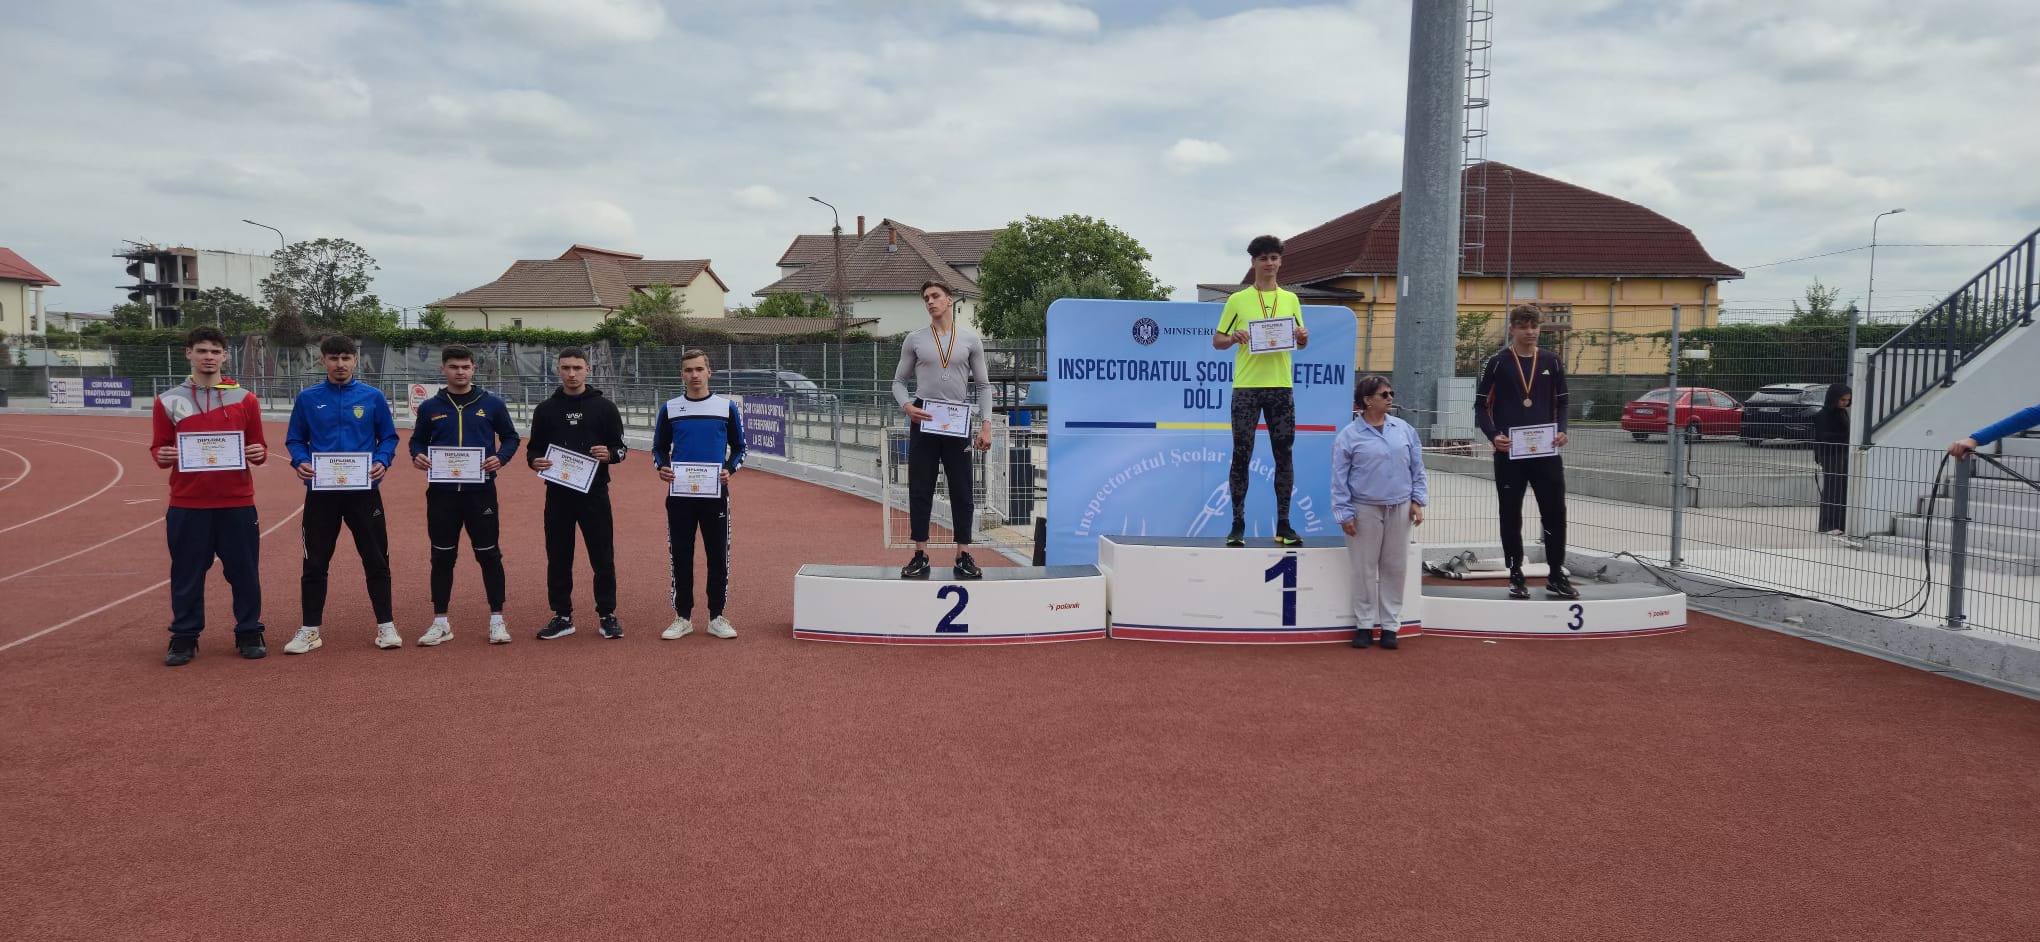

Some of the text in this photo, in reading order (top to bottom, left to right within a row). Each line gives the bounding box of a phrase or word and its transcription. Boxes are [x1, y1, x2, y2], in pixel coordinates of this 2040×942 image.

[1163, 328, 1217, 336] MINISTERU
[1058, 358, 1345, 389] INSPECTORATUL ȘCOL EȚEAN
[1183, 388, 1223, 410] DOLJ
[1075, 452, 1166, 536] Inspectoratul
[1170, 447, 1226, 468] Școlar
[1297, 496, 1324, 532] Dolj
[1264, 551, 1297, 626] 1
[935, 584, 969, 633] 2
[1567, 603, 1584, 631] 3
